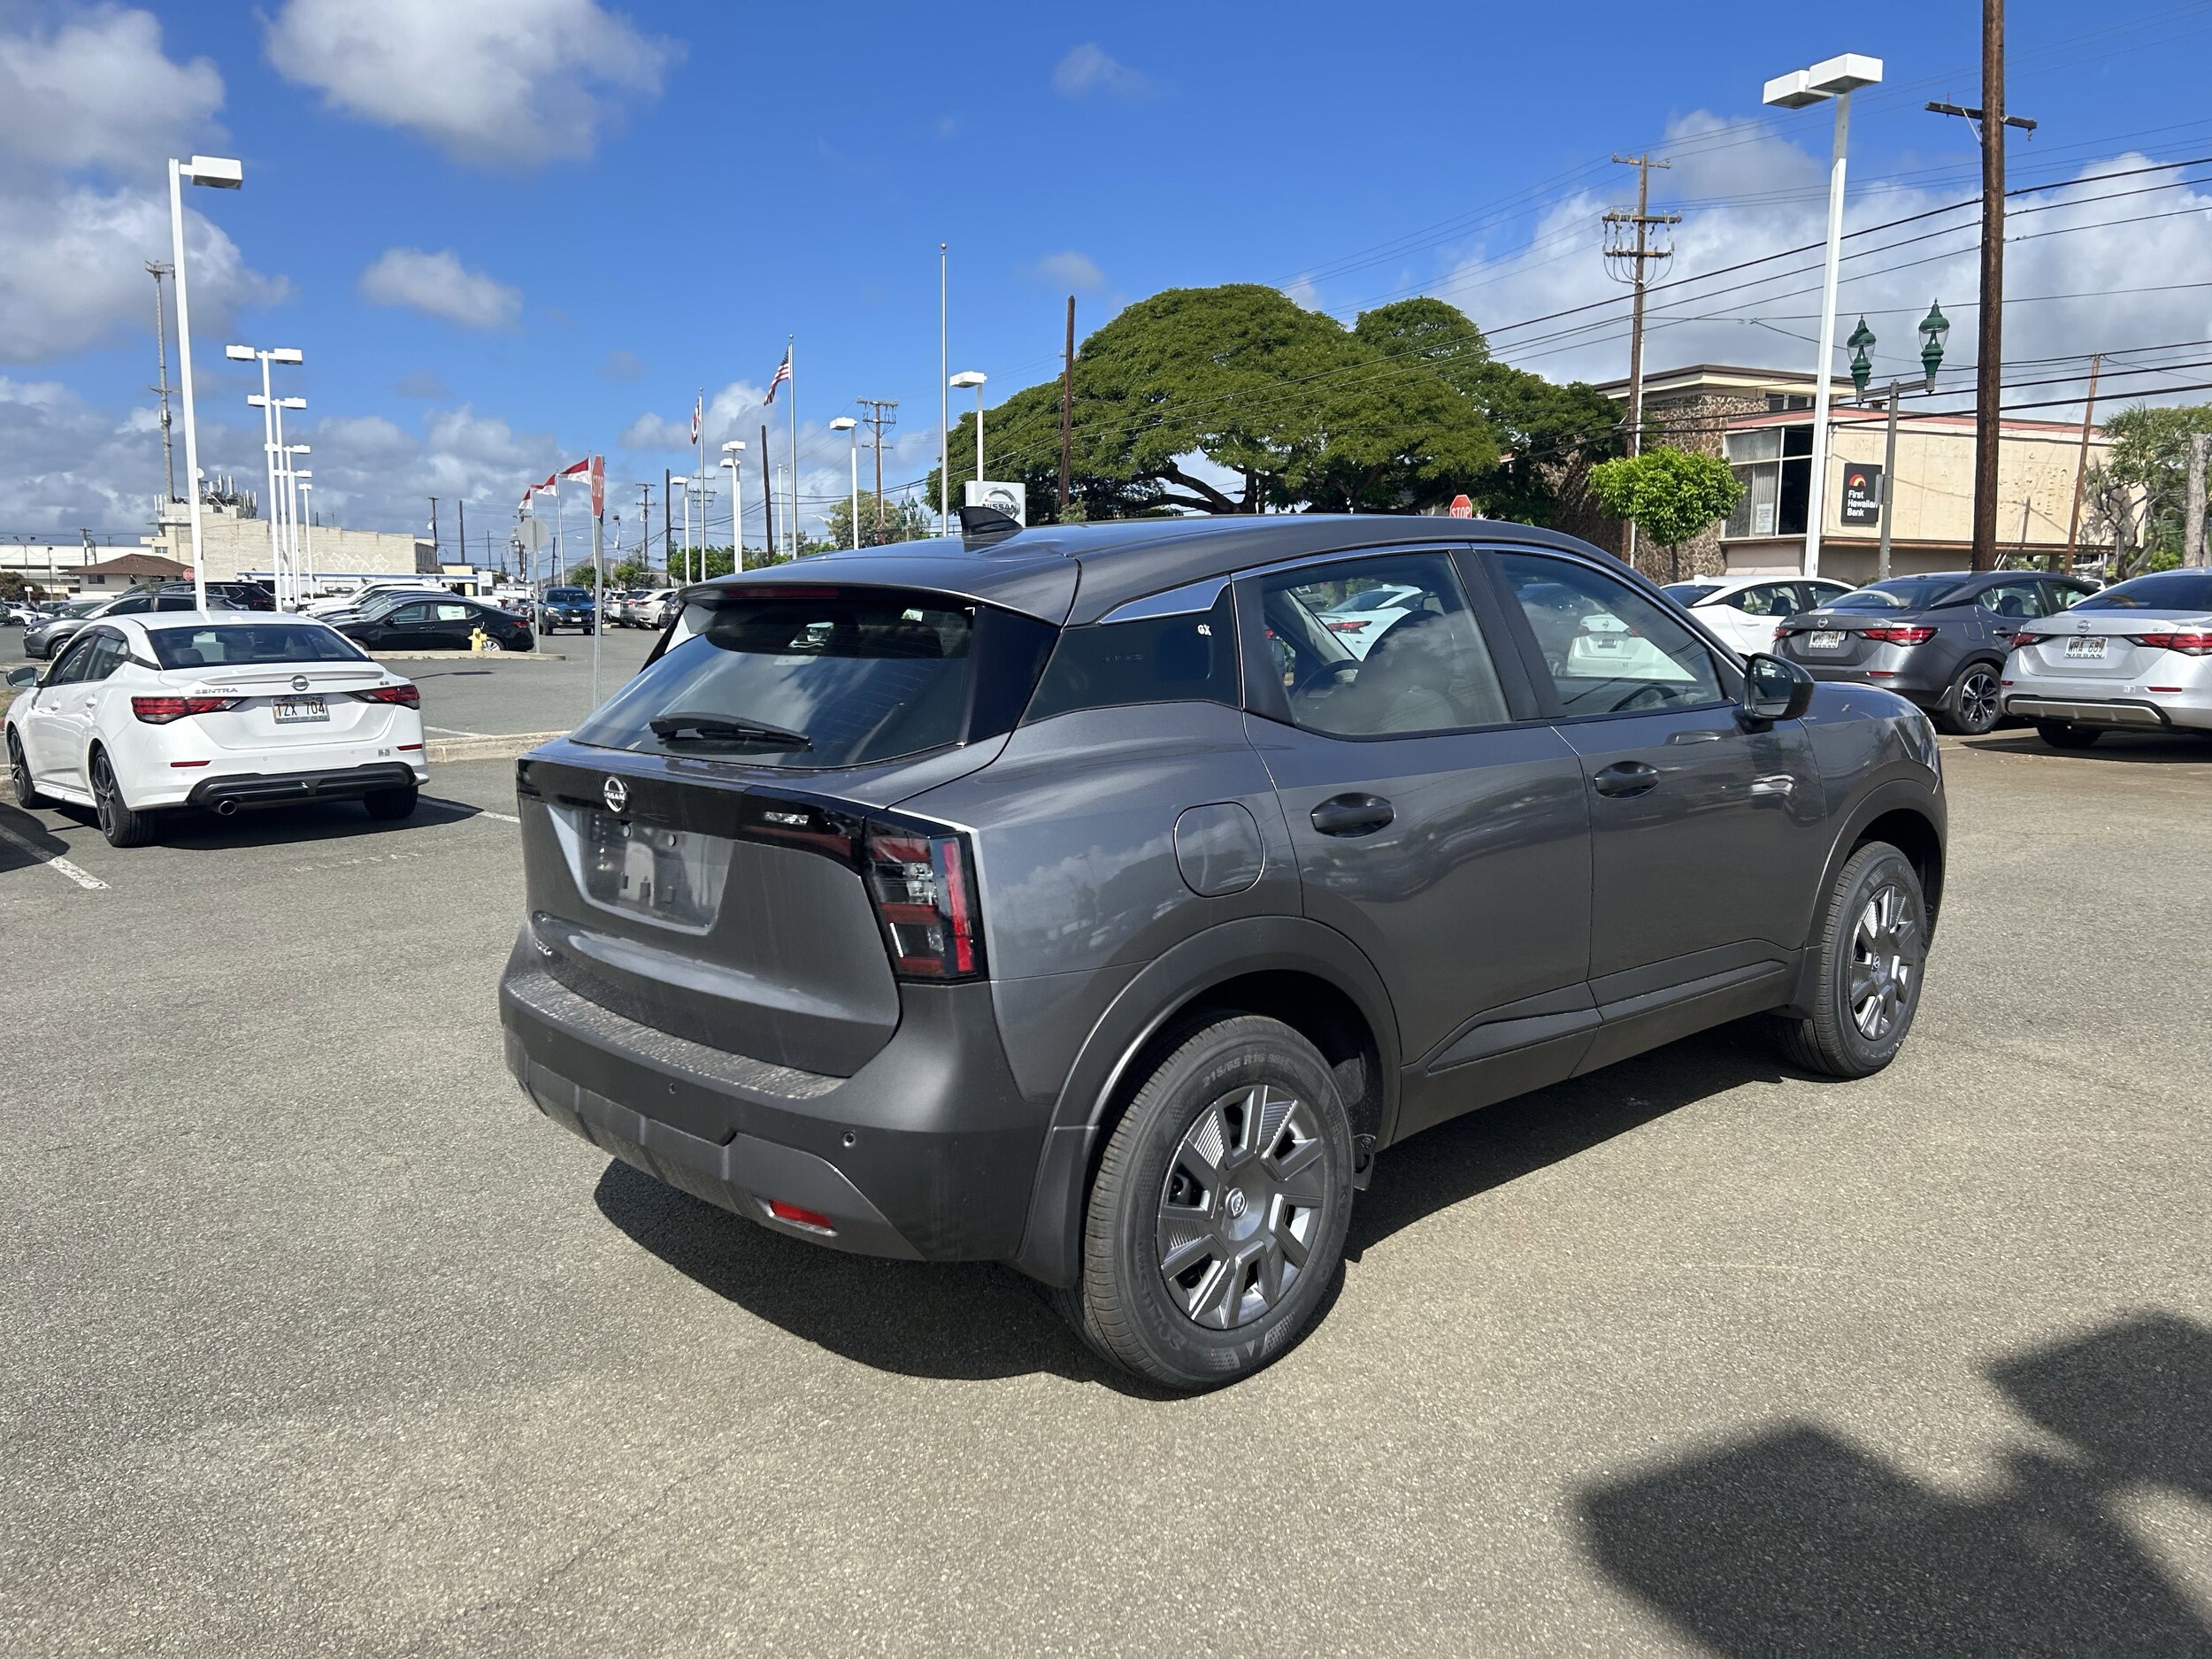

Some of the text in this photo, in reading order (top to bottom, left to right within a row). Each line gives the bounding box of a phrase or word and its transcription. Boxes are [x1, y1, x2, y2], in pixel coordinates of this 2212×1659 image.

[592, 474, 603, 497] STOP
[1847, 489, 1864, 499] First
[1451, 506, 1471, 518] STOP
[1847, 507, 1864, 517] Bank
[303, 701, 326, 716] 704
